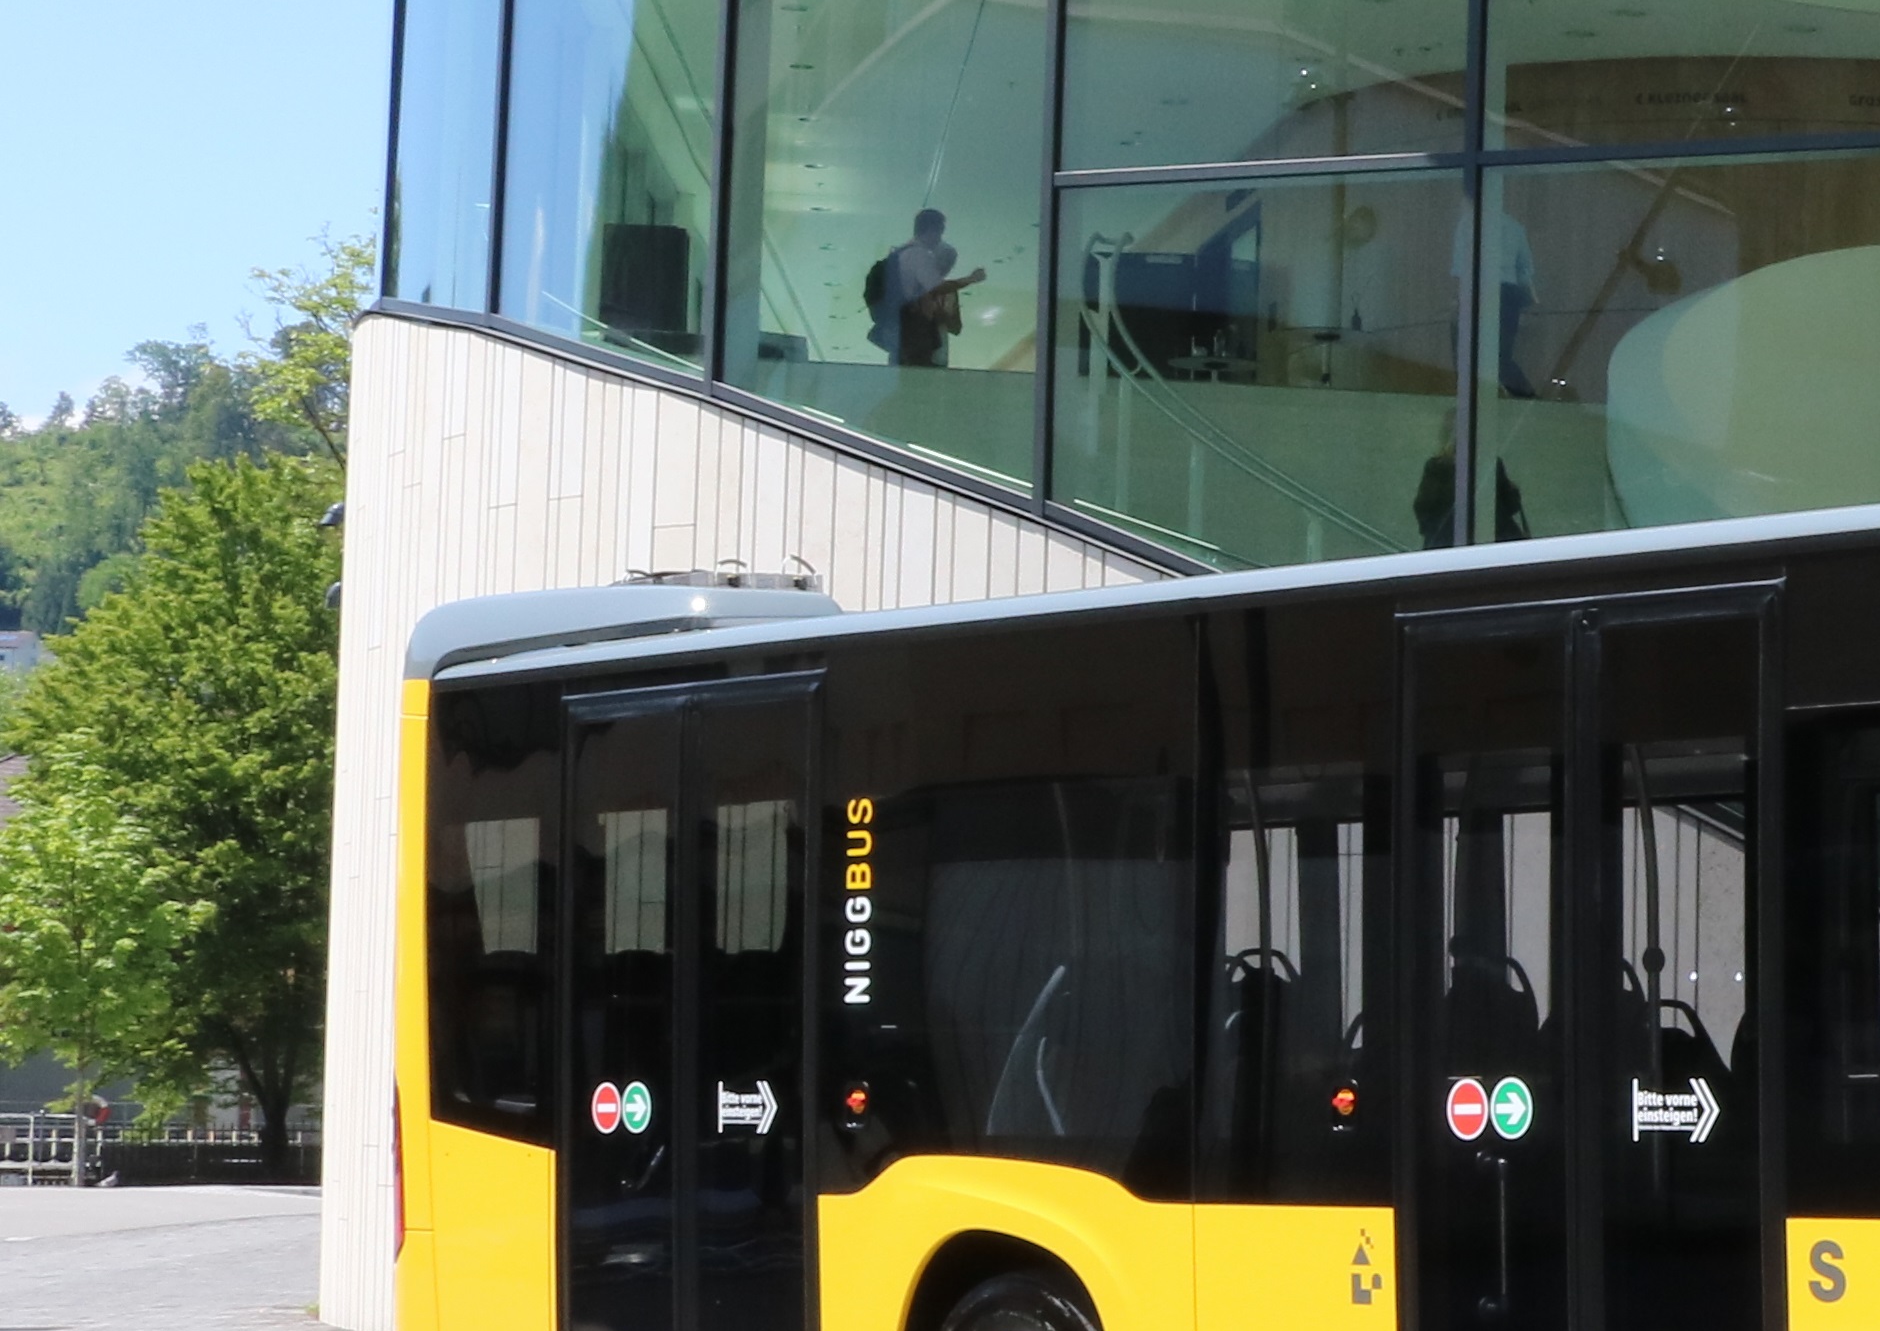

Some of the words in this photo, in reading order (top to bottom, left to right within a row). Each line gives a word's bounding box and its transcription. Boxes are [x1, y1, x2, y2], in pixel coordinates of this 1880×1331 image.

[844, 796, 873, 1005] NIGGBUS
[1638, 1090, 1664, 1107] Bitte
[1664, 1093, 1698, 1107] vorne
[1638, 1107, 1698, 1126] einsteigen!
